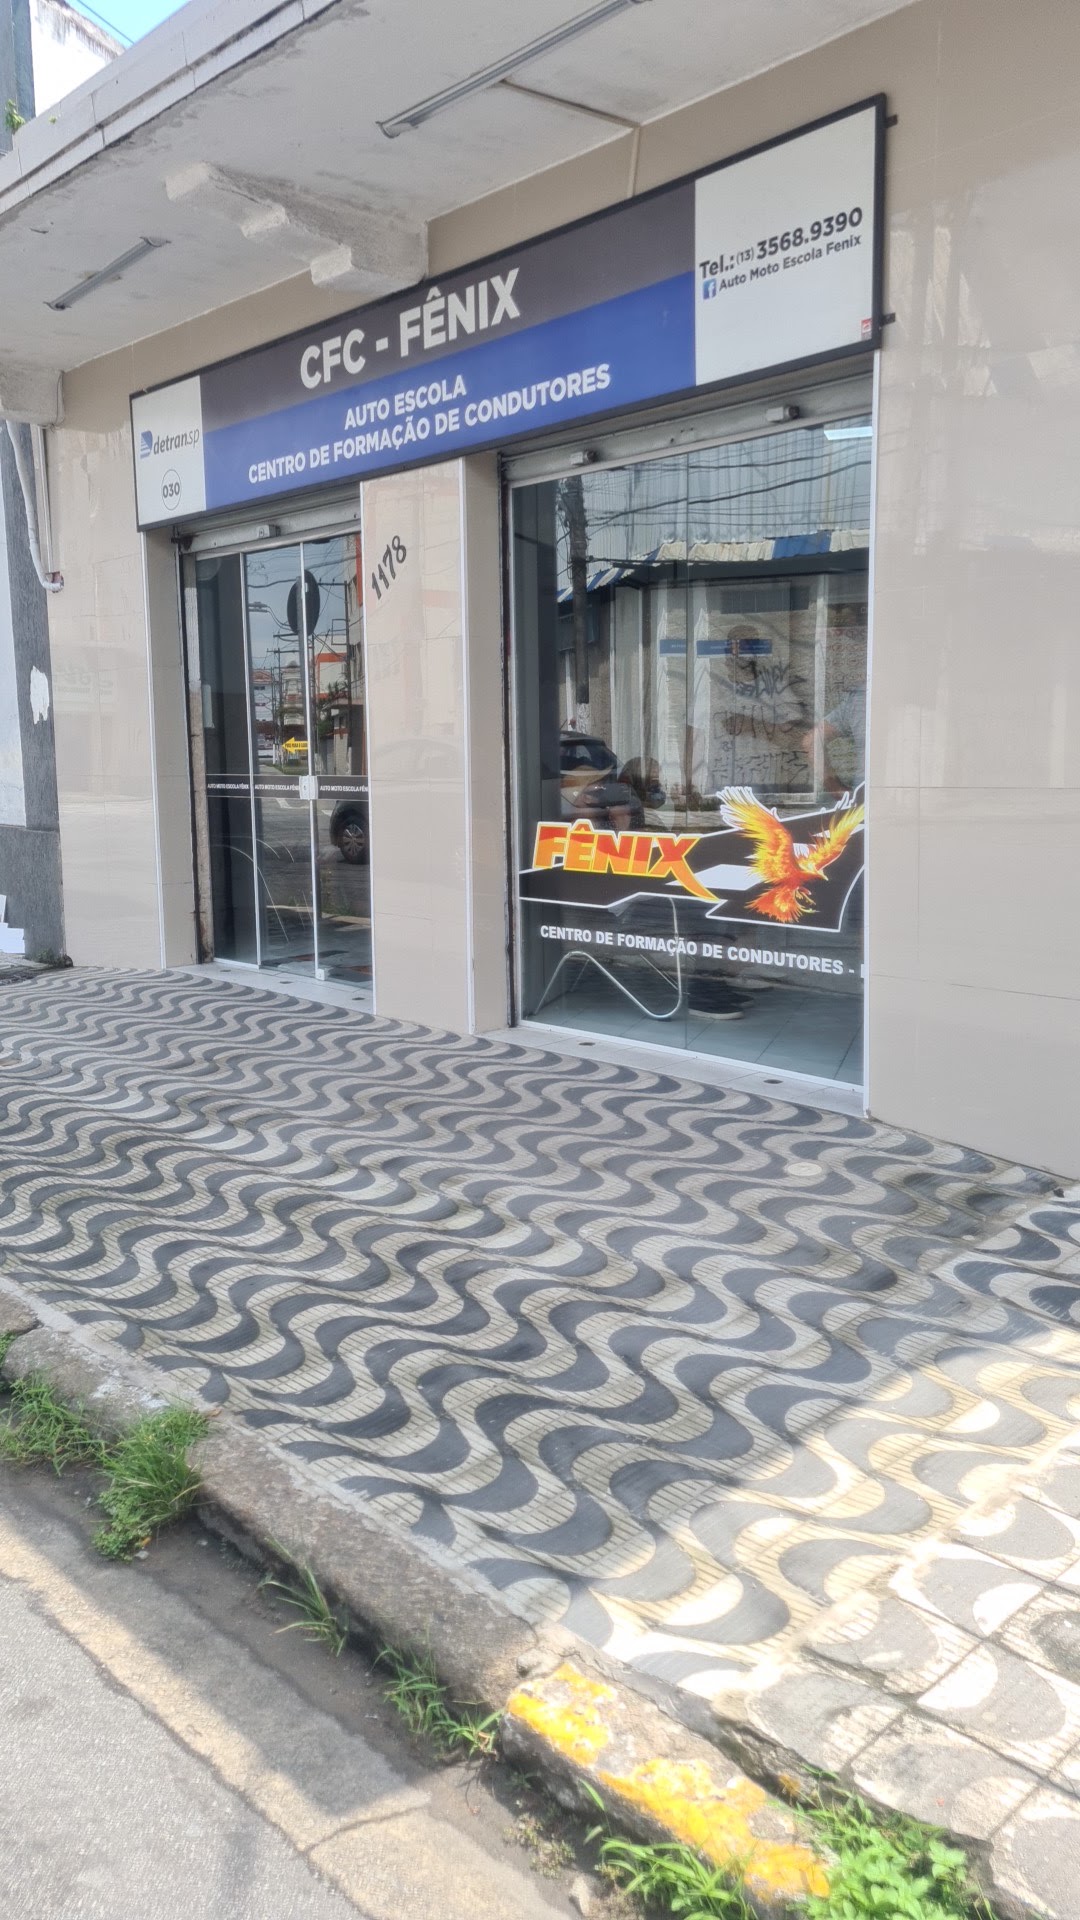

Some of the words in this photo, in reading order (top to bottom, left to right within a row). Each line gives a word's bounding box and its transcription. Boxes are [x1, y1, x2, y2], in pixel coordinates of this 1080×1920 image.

[699, 254, 735, 279] Tel.:
[736, 246, 755, 266] (13)
[757, 207, 863, 260] 3568.9390
[719, 273, 747, 291] Auto
[750, 263, 780, 281] Moto
[783, 247, 823, 270] Escola
[826, 234, 862, 255] Fenix
[300, 328, 366, 389] CFC
[399, 267, 521, 358] FÊNIX
[248, 452, 306, 484] CENTRO
[309, 444, 330, 468] DE
[333, 415, 430, 462] FORMAÇÃO
[435, 407, 460, 436] DE
[464, 363, 612, 427] CONDUTORES
[344, 398, 390, 431] AUTO
[394, 374, 467, 416] ESCOLA
[162, 482, 181, 499] 030
[371, 534, 407, 601] 1178
[532, 819, 720, 901] FÊNIX
[540, 924, 592, 944] CENTRO
[595, 931, 614, 947] DE
[617, 933, 698, 957] FORMAÇÃO
[702, 943, 723, 959] DE
[727, 946, 844, 975] CONDUTORES
